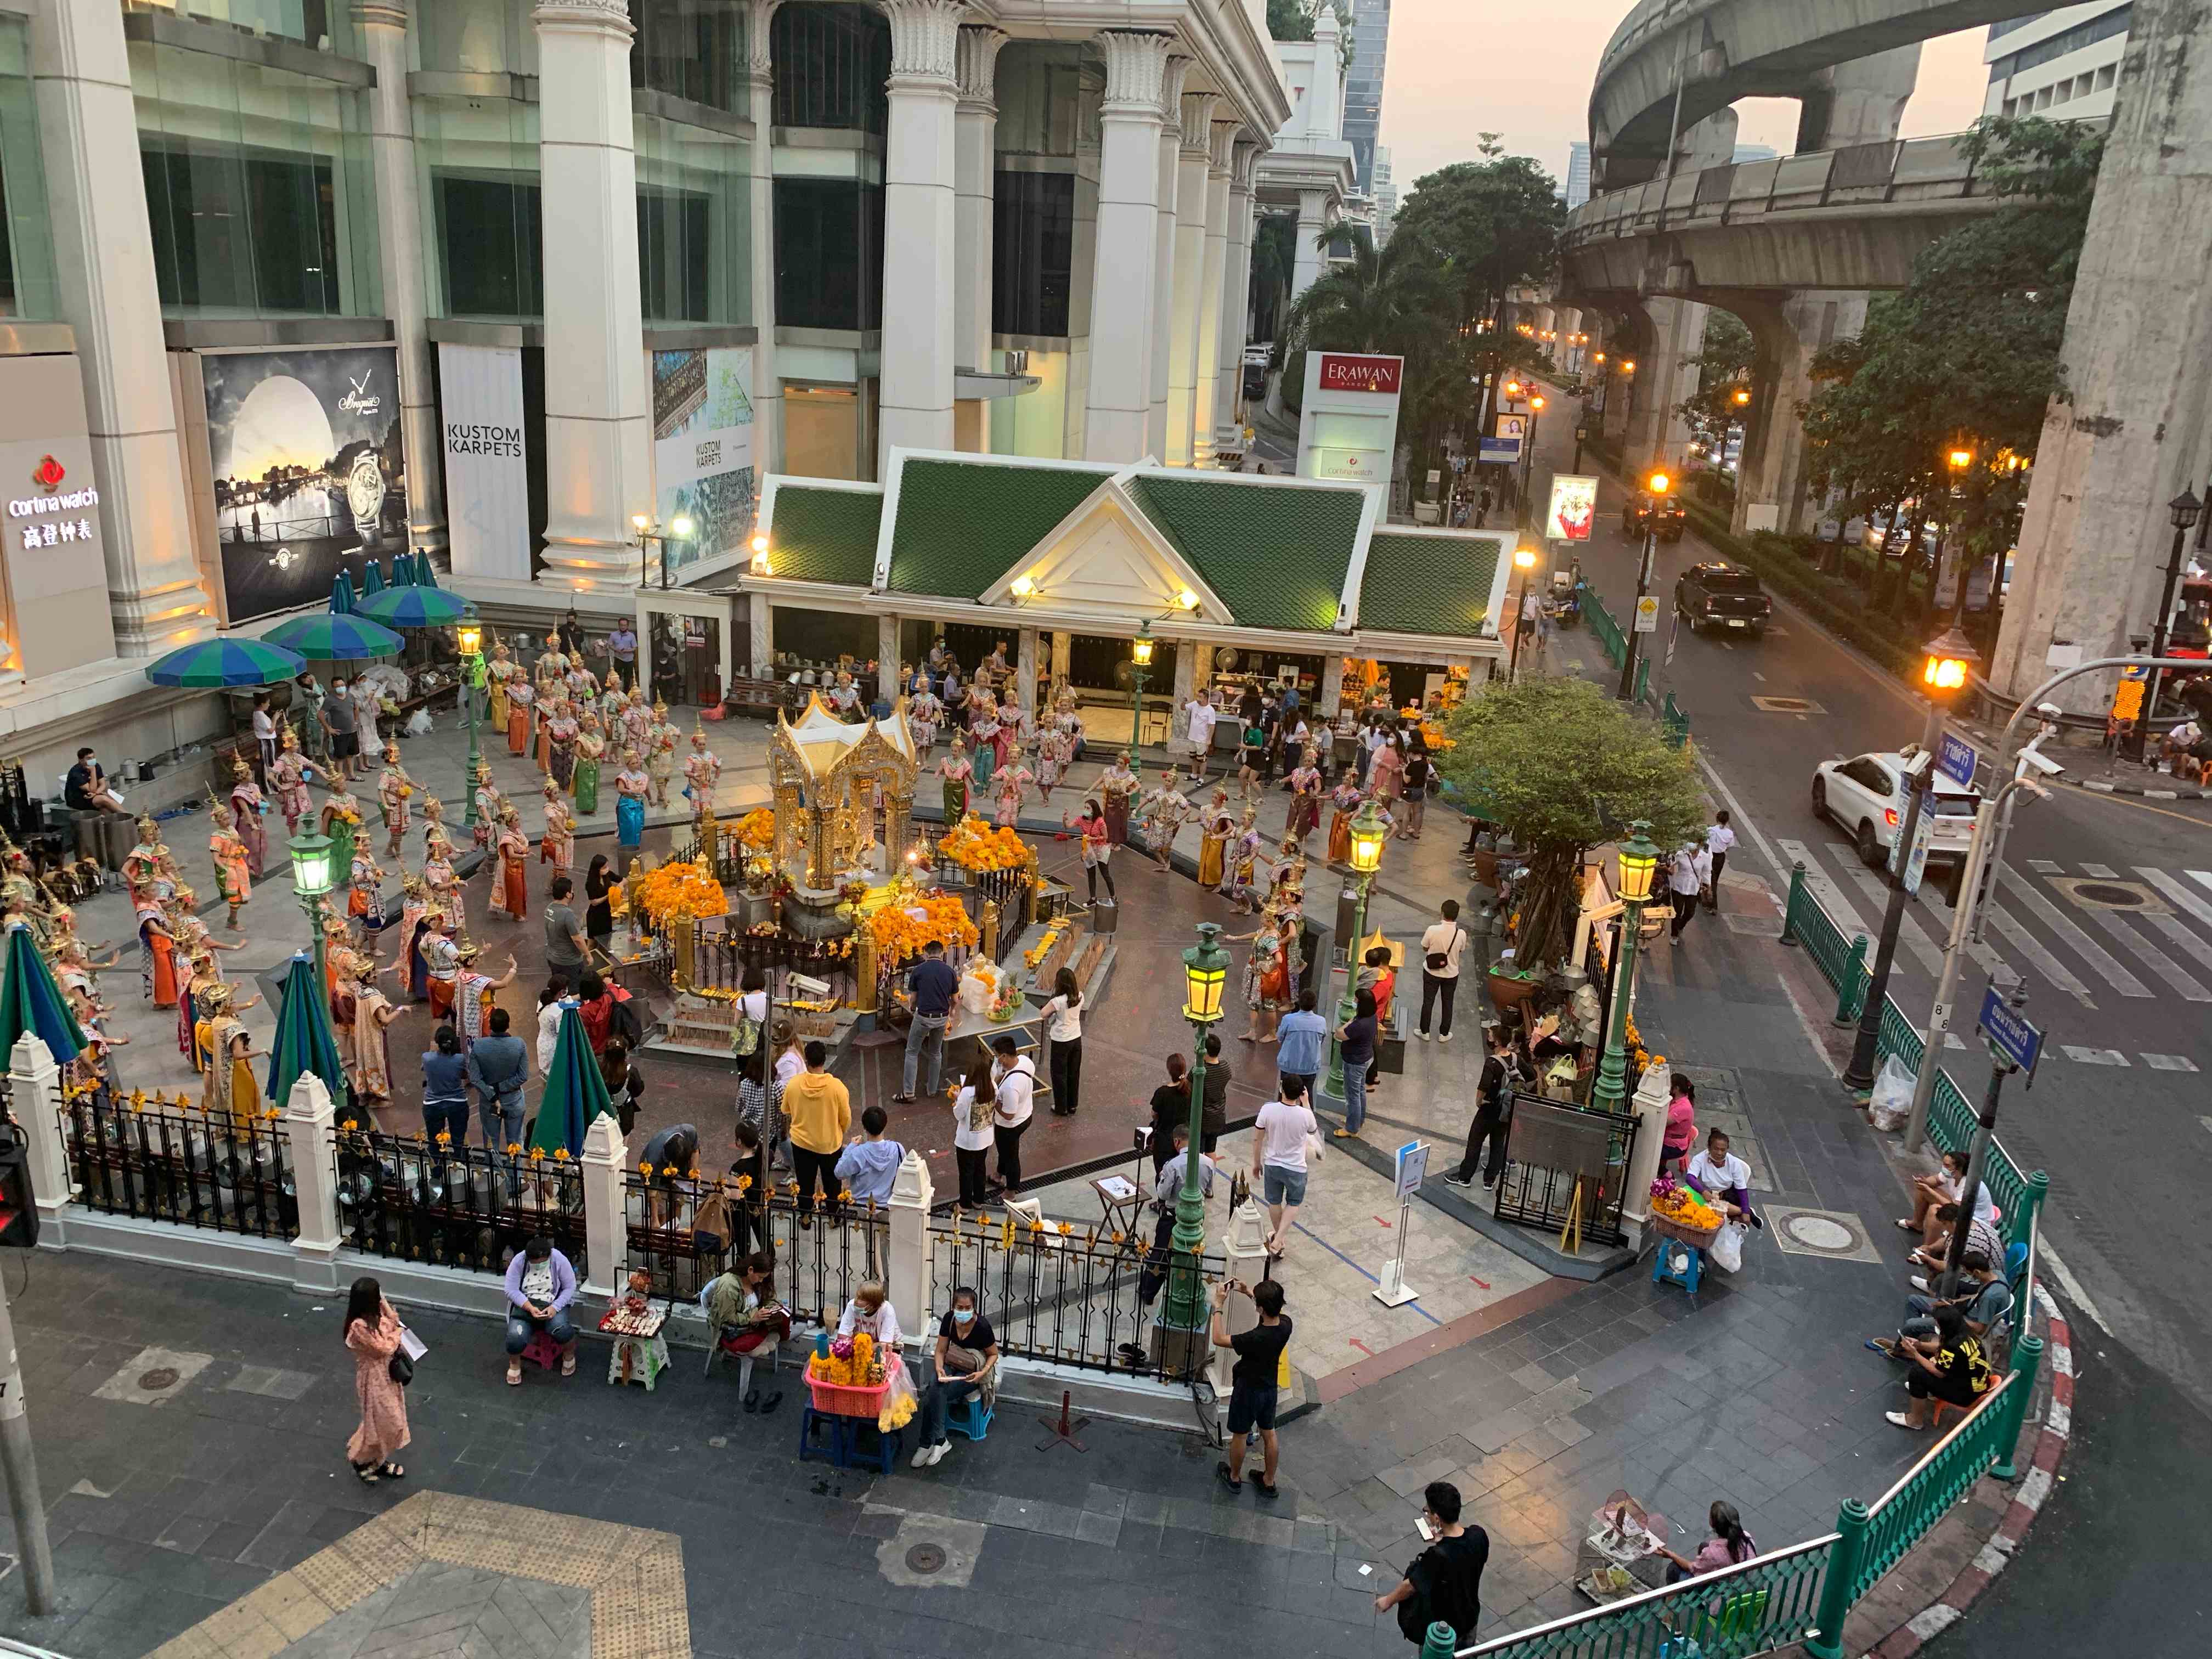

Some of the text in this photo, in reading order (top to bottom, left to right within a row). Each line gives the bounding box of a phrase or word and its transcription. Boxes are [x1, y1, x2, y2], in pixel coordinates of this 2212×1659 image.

[1328, 363, 1393, 382] ERAWAN
[338, 391, 380, 416] Breguet
[448, 424, 520, 442] KUSTOM
[449, 439, 521, 457] KARPETS
[696, 439, 721, 455] KUSTOM
[697, 453, 721, 469] KARPETS
[9, 487, 99, 517] Cortina watch
[22, 518, 93, 549] 高登钟表
[1935, 1005, 1943, 1015] 8
